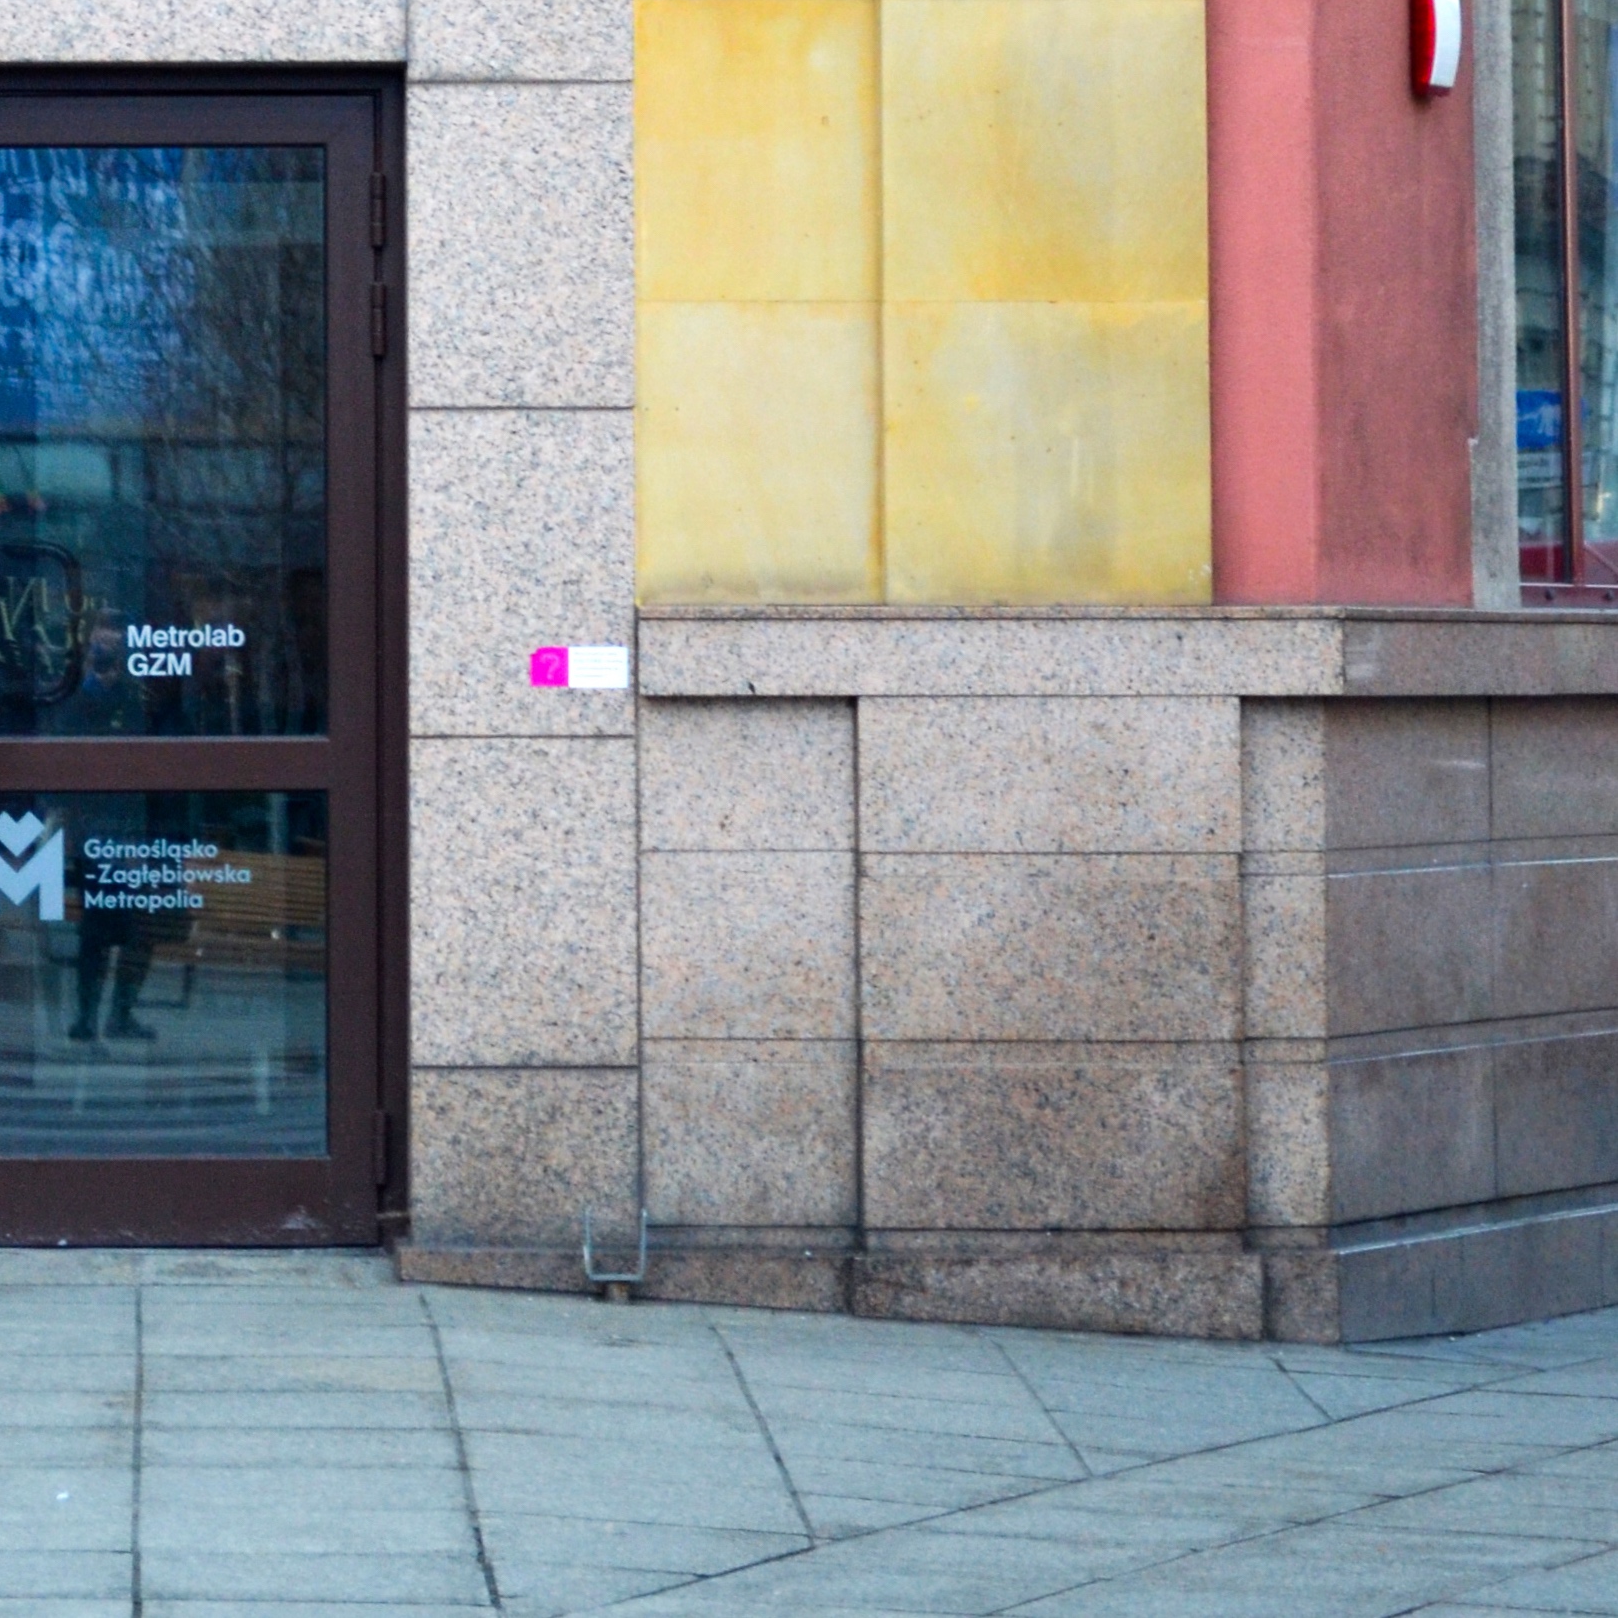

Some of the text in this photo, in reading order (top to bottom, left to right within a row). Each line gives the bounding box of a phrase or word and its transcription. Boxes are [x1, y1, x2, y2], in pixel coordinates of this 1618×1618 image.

[127, 623, 246, 648] Metrolab
[127, 652, 192, 676] GZM
[83, 838, 218, 862] Górnośląsko
[85, 863, 252, 888] -Zagłębiowska
[84, 890, 204, 912] Metropolia
